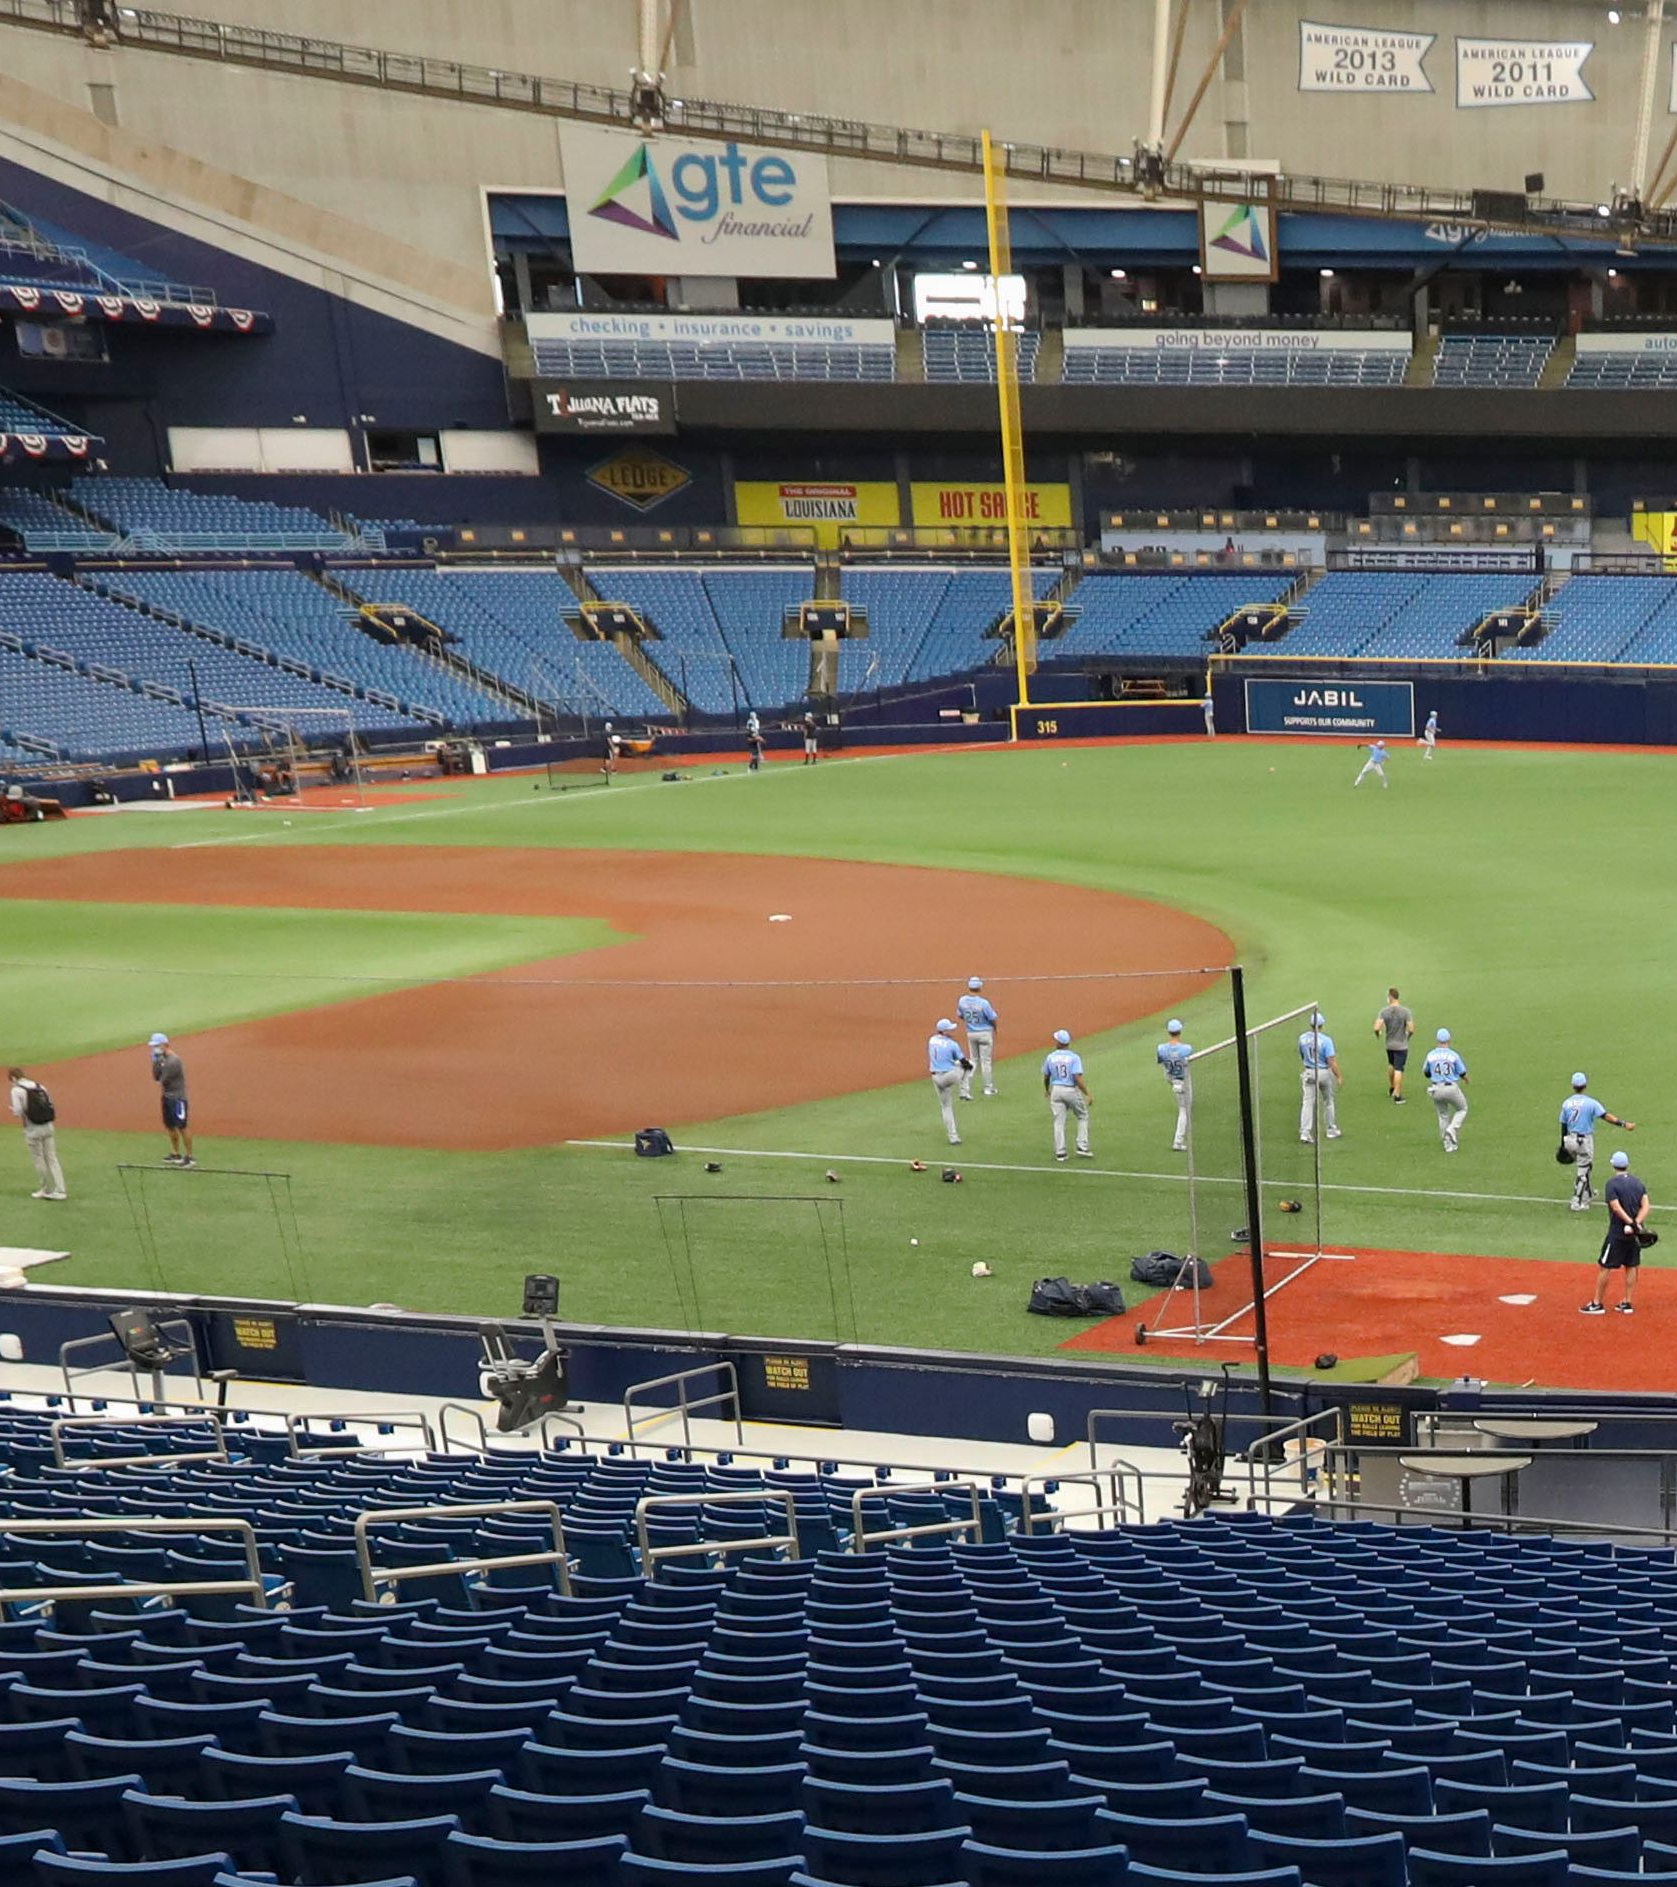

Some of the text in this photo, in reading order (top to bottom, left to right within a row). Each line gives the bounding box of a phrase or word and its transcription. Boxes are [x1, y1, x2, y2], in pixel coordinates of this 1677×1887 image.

[1306, 32, 1422, 50] AMERICAN LEAGUE
[1333, 49, 1397, 71] 2013
[1462, 48, 1580, 60] AMERICAN LEAGUE
[1315, 71, 1411, 88] WILD CARD
[1491, 61, 1554, 84] 2011
[1472, 84, 1570, 98] WILD CARD
[672, 141, 797, 222] gte
[701, 212, 814, 244] financial
[569, 317, 853, 341] checking insurance savings
[1154, 331, 1320, 350] going beyond money
[1644, 335, 1677, 349] auto
[616, 394, 659, 415] FLATS
[609, 461, 670, 489] LEDGE
[783, 486, 853, 497] THE ORIGINAL
[785, 500, 856, 519] LOUISIANA
[939, 491, 977, 519] HOT
[1293, 689, 1364, 707] JABIL
[1037, 720, 1058, 734] 315
[1283, 716, 1317, 727] SUPPORTS
[1332, 717, 1375, 728] COMMUNITY
[1434, 1061, 1451, 1077] 43
[1351, 1413, 1401, 1424] WATCH OUT
